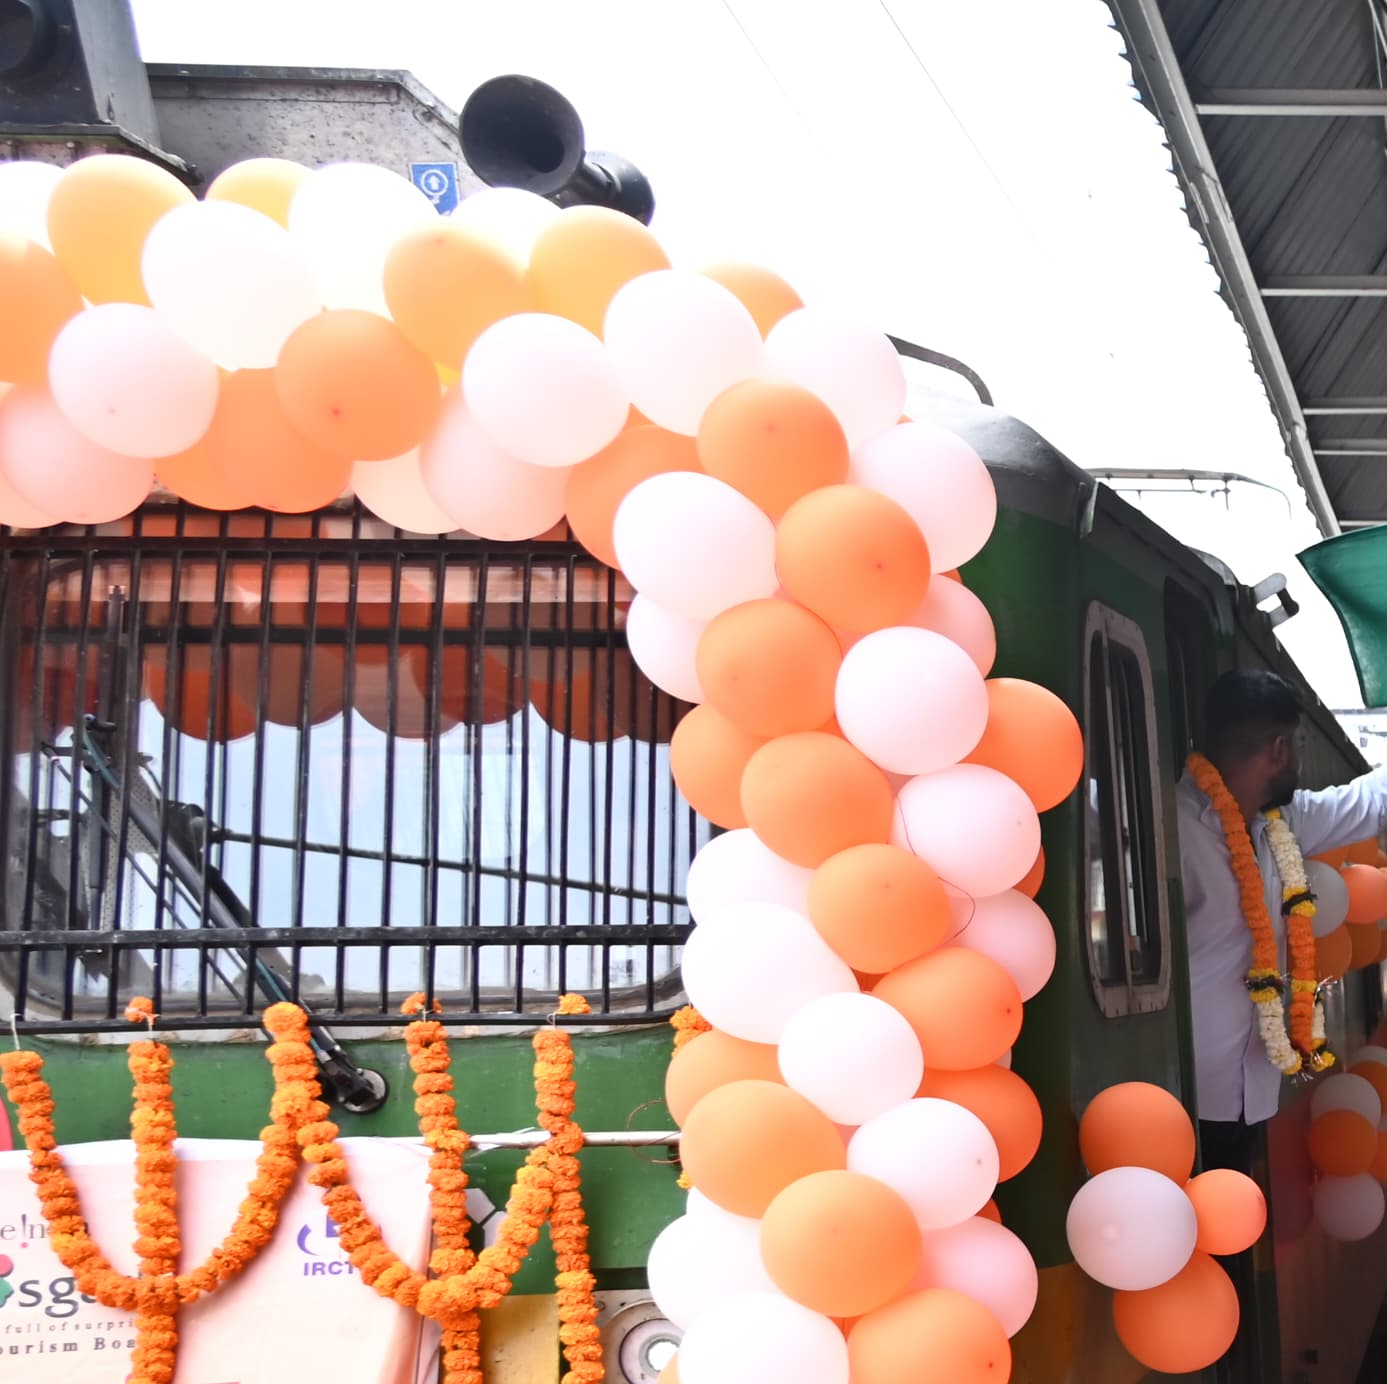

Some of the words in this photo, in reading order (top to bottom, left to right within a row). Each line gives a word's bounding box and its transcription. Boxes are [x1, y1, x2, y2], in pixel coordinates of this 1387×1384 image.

[303, 1260, 354, 1276] IRCT
[74, 1319, 134, 1332] surpri
[94, 1337, 136, 1351] Boa
